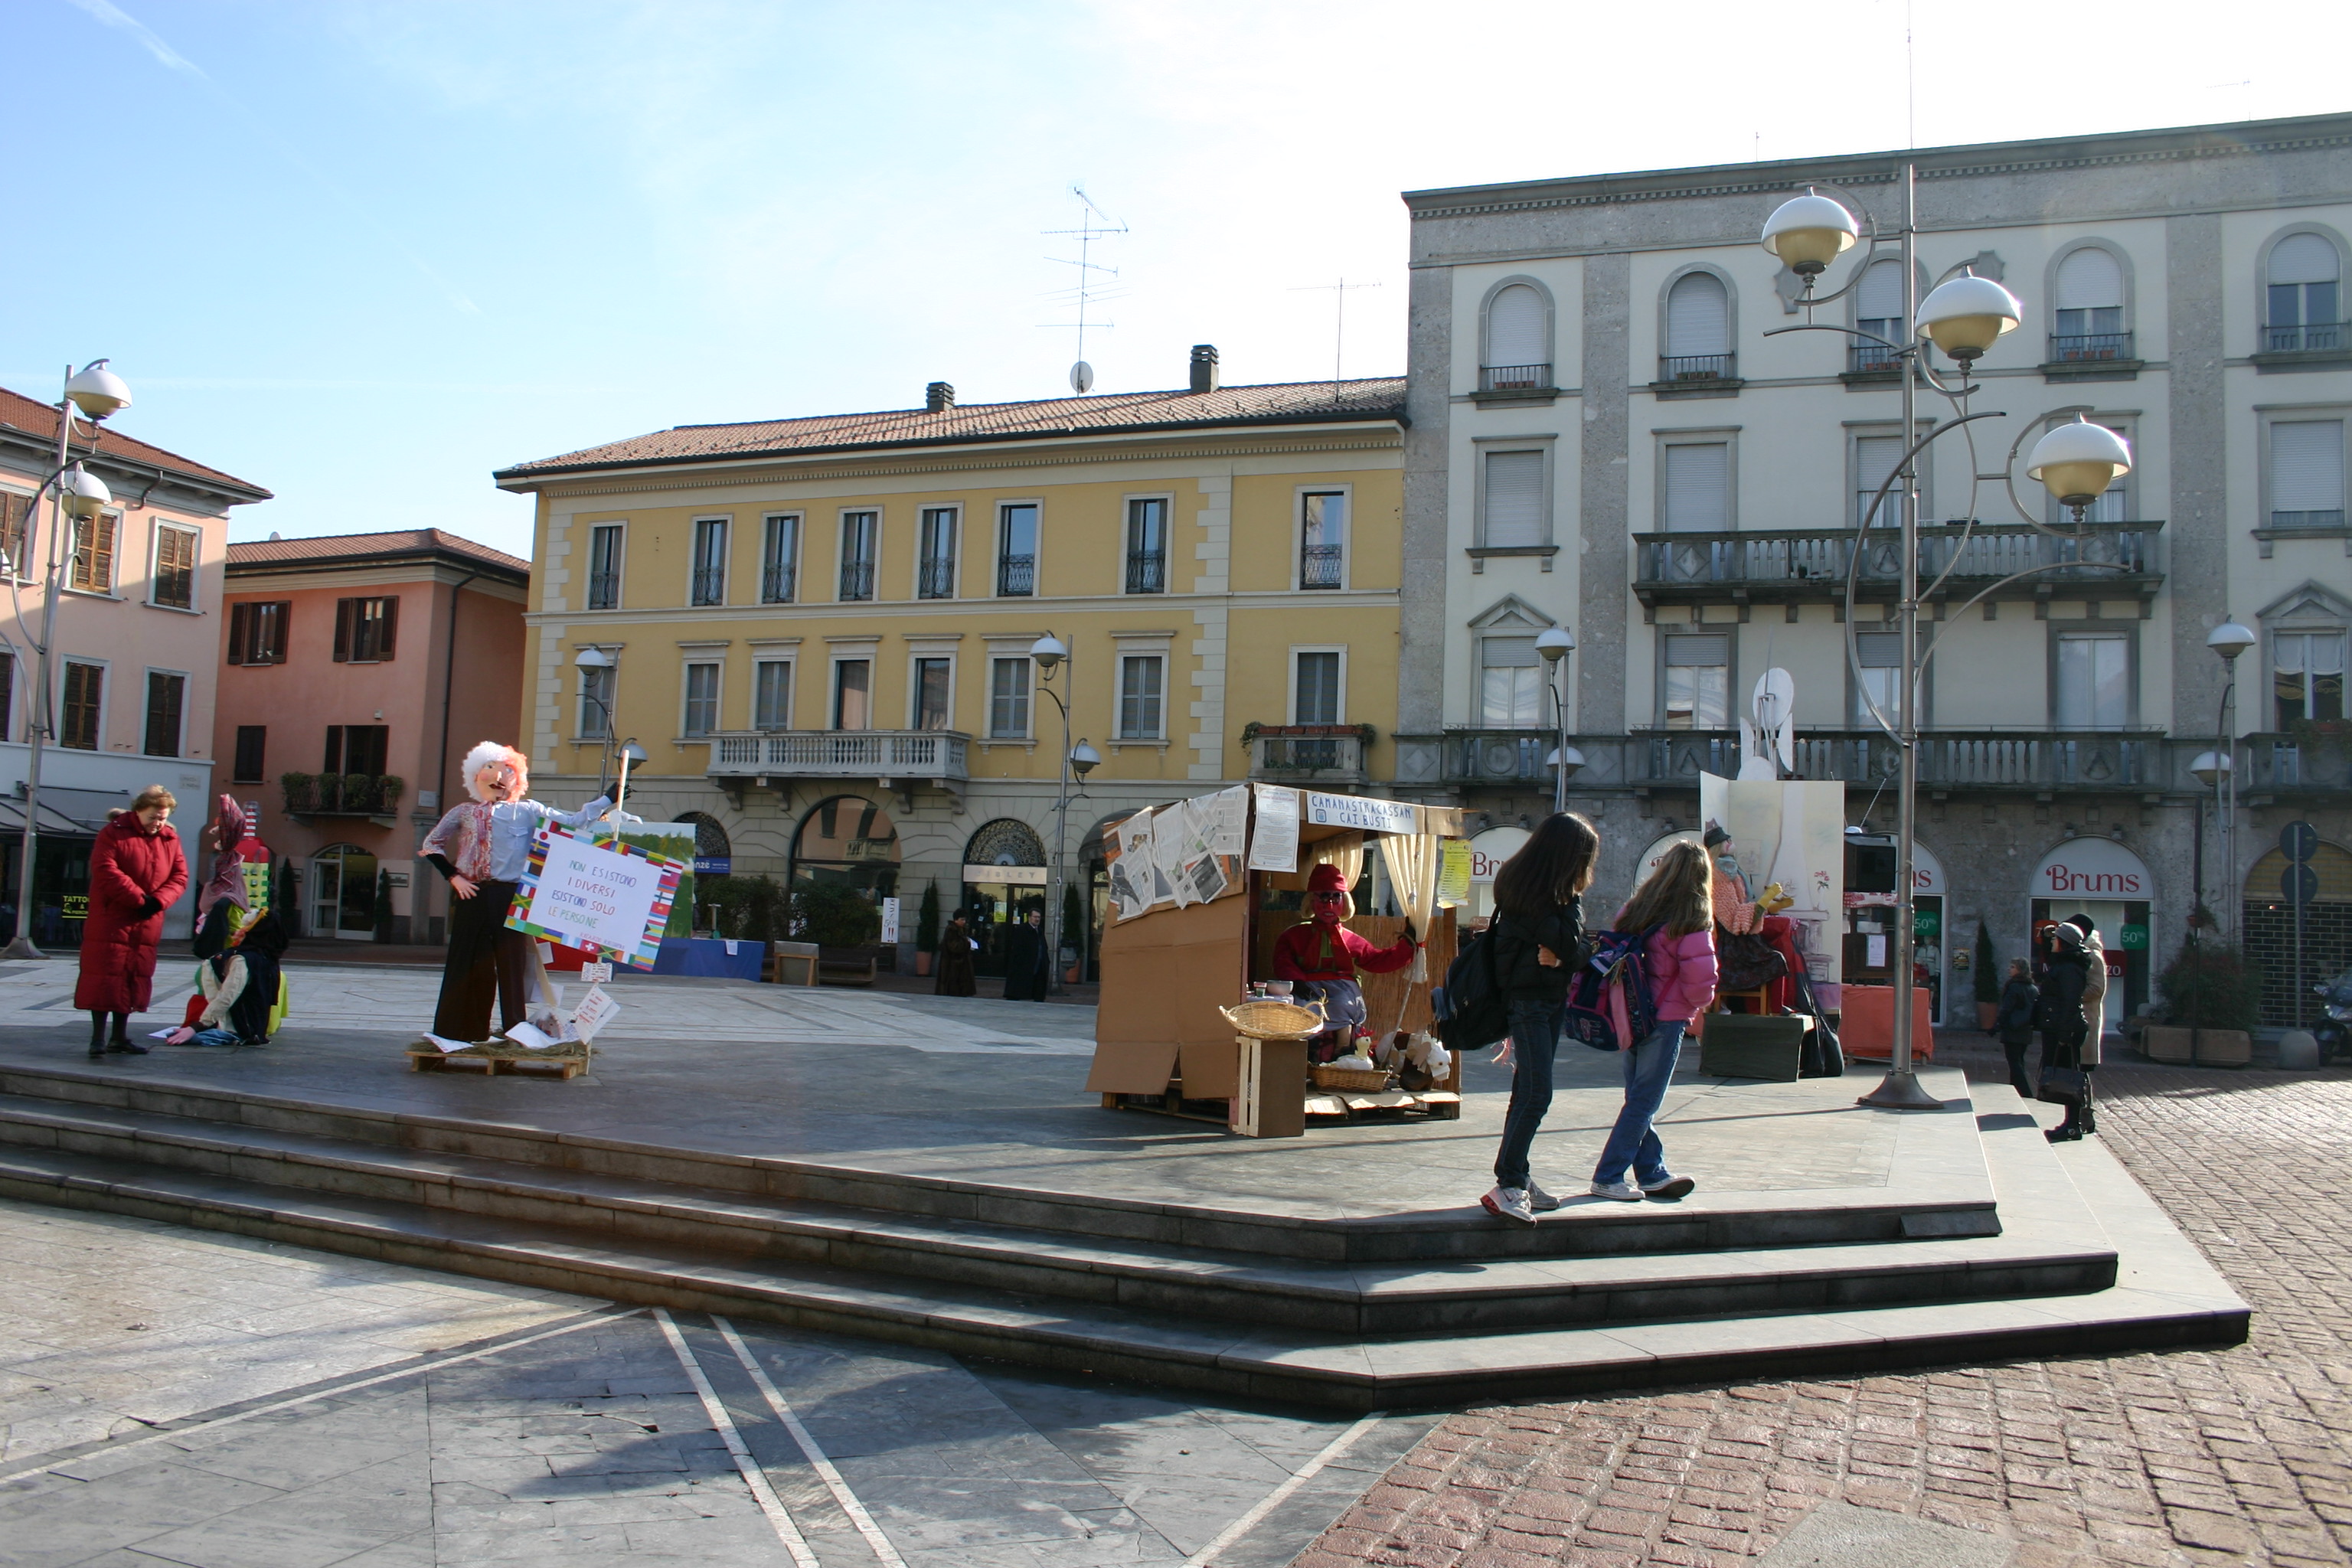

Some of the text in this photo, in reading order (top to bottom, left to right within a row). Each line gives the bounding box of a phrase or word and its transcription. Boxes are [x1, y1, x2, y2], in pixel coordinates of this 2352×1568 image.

[1363, 814, 1392, 829] BUSTI
[569, 860, 637, 888] NON ESISTONO
[2045, 864, 2140, 893] Brums
[567, 877, 616, 898] I DIVERSI
[551, 890, 616, 916] ESISTONO SOLO
[548, 906, 599, 929] LE PERSONE
